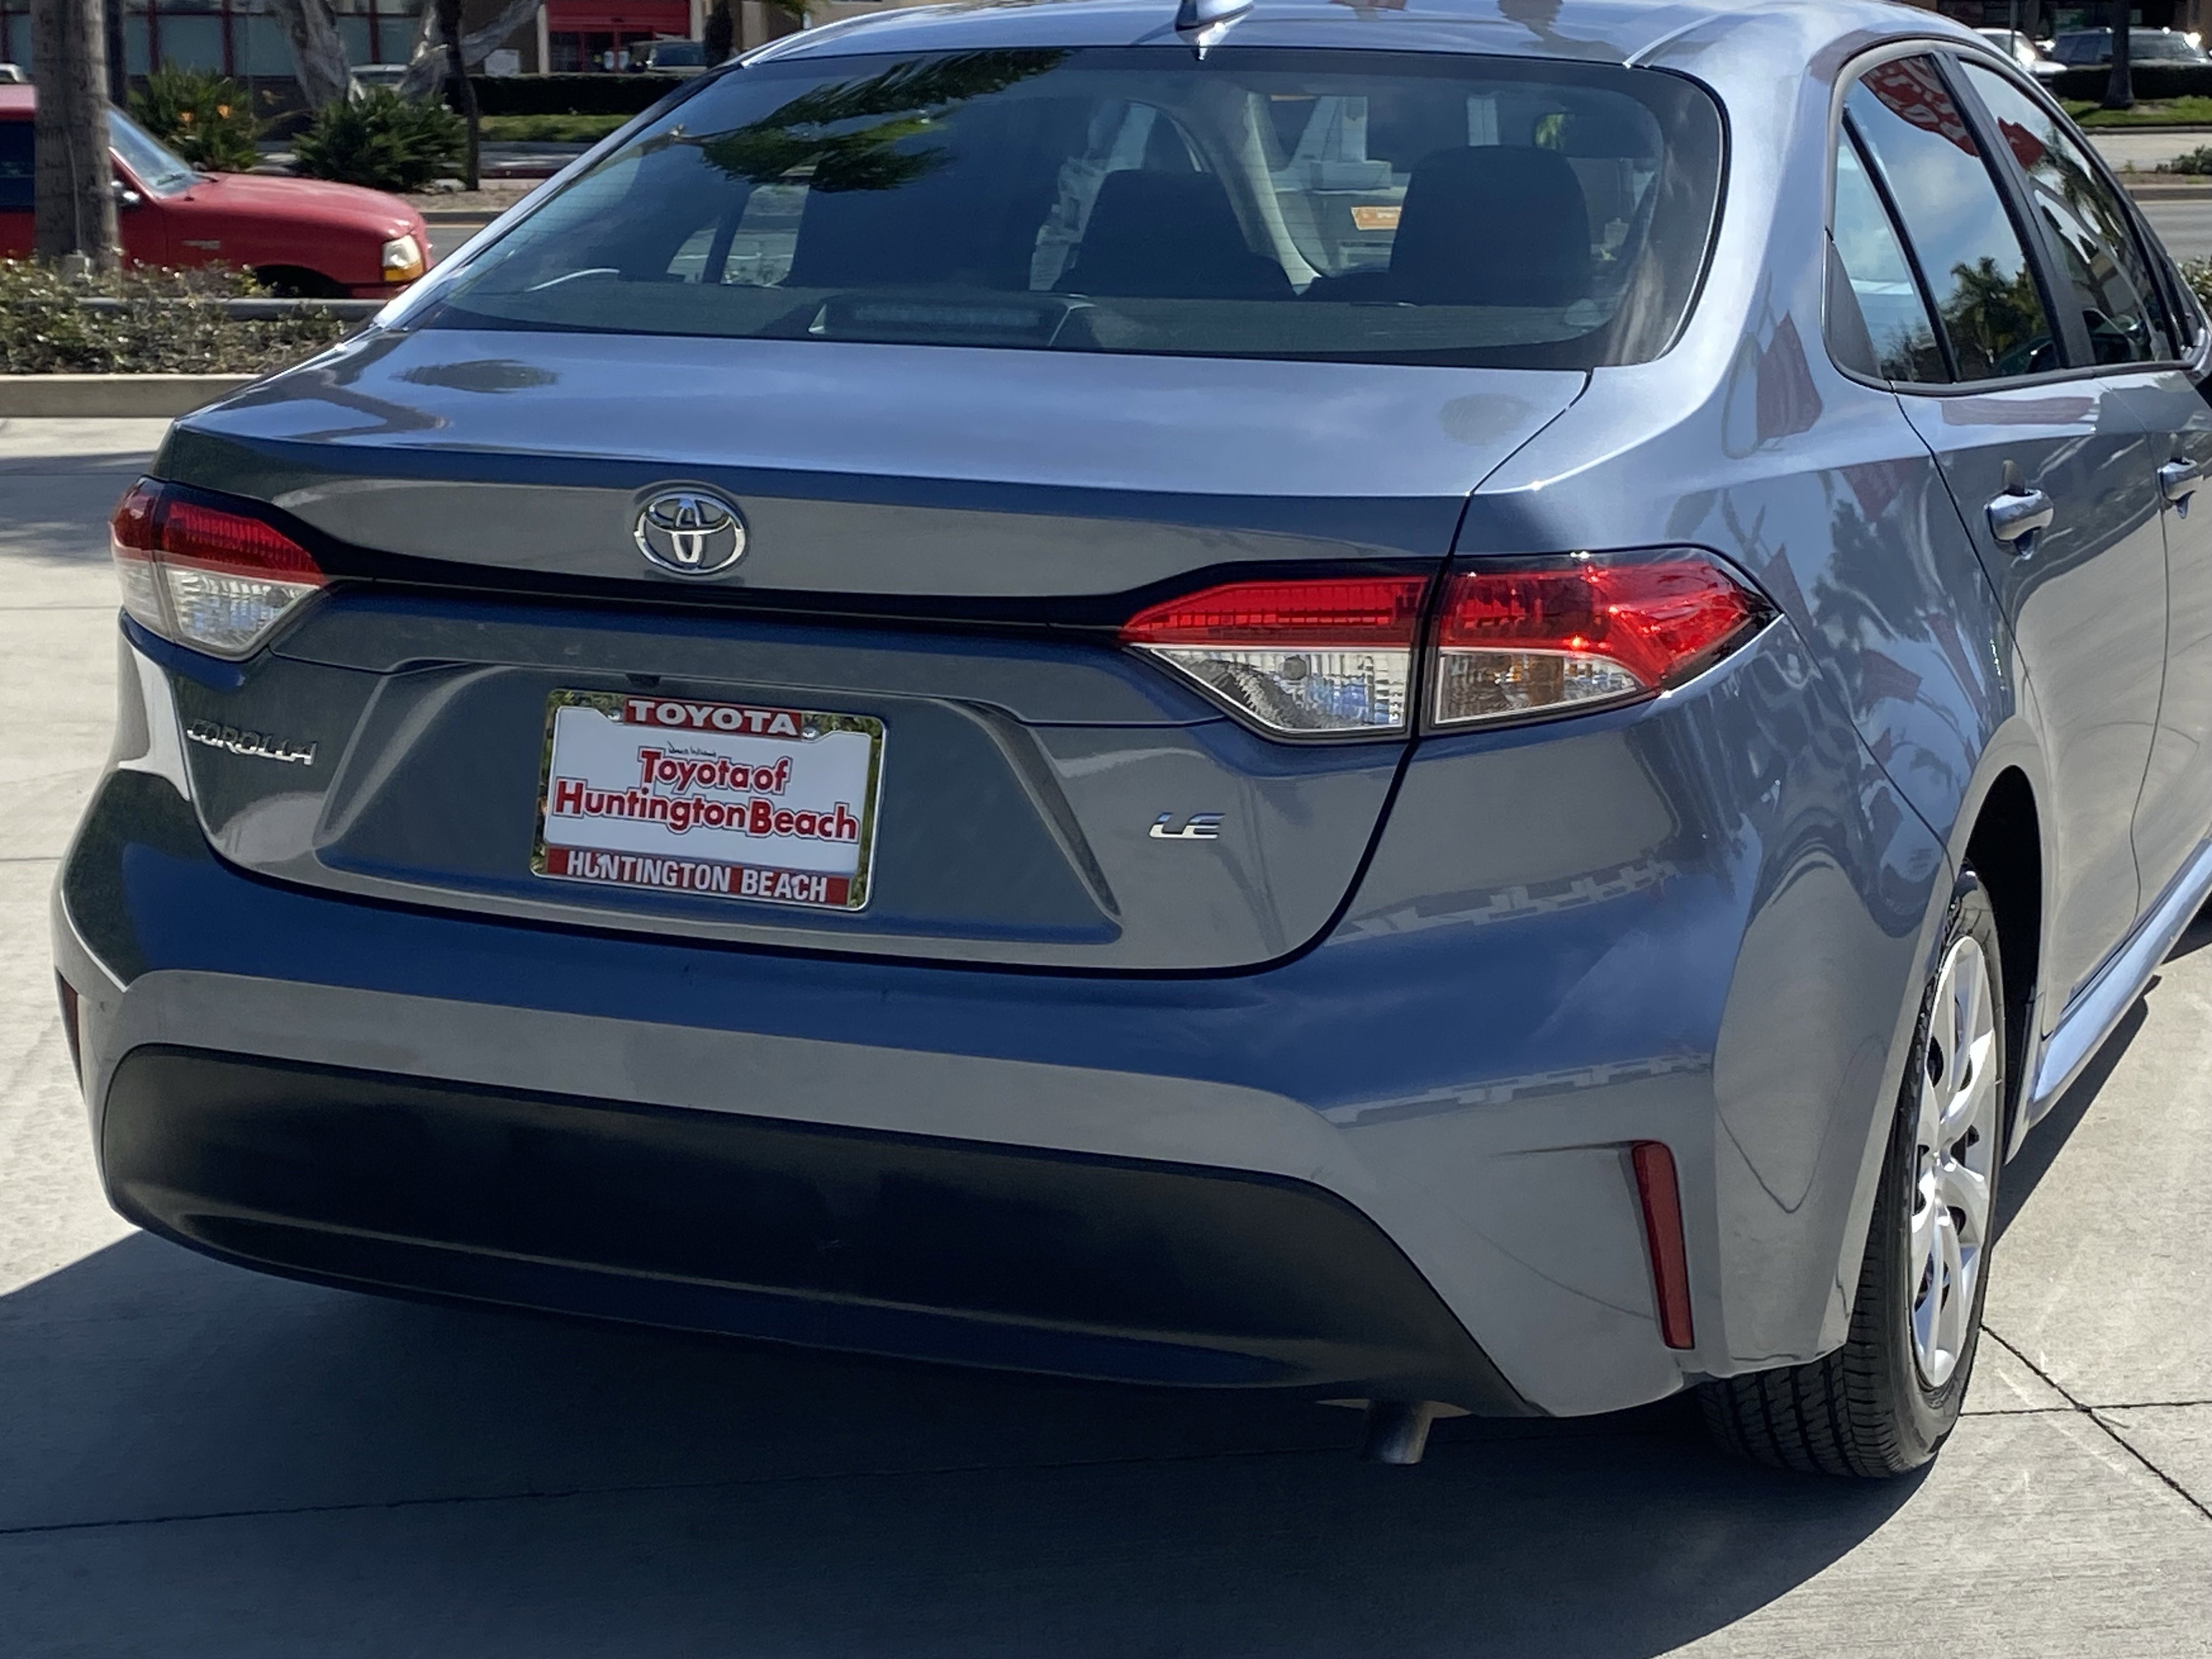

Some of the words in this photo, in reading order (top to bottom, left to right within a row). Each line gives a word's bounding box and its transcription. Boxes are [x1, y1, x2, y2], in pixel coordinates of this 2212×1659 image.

[629, 700, 797, 735] TOYOTA
[641, 749, 749, 792] Toyota
[753, 758, 789, 792] of
[555, 780, 746, 832] Huntington
[748, 800, 857, 840] Beach
[1149, 812, 1226, 839] LE
[567, 850, 731, 893] HUNTINGTON
[741, 868, 827, 902] BEACH
